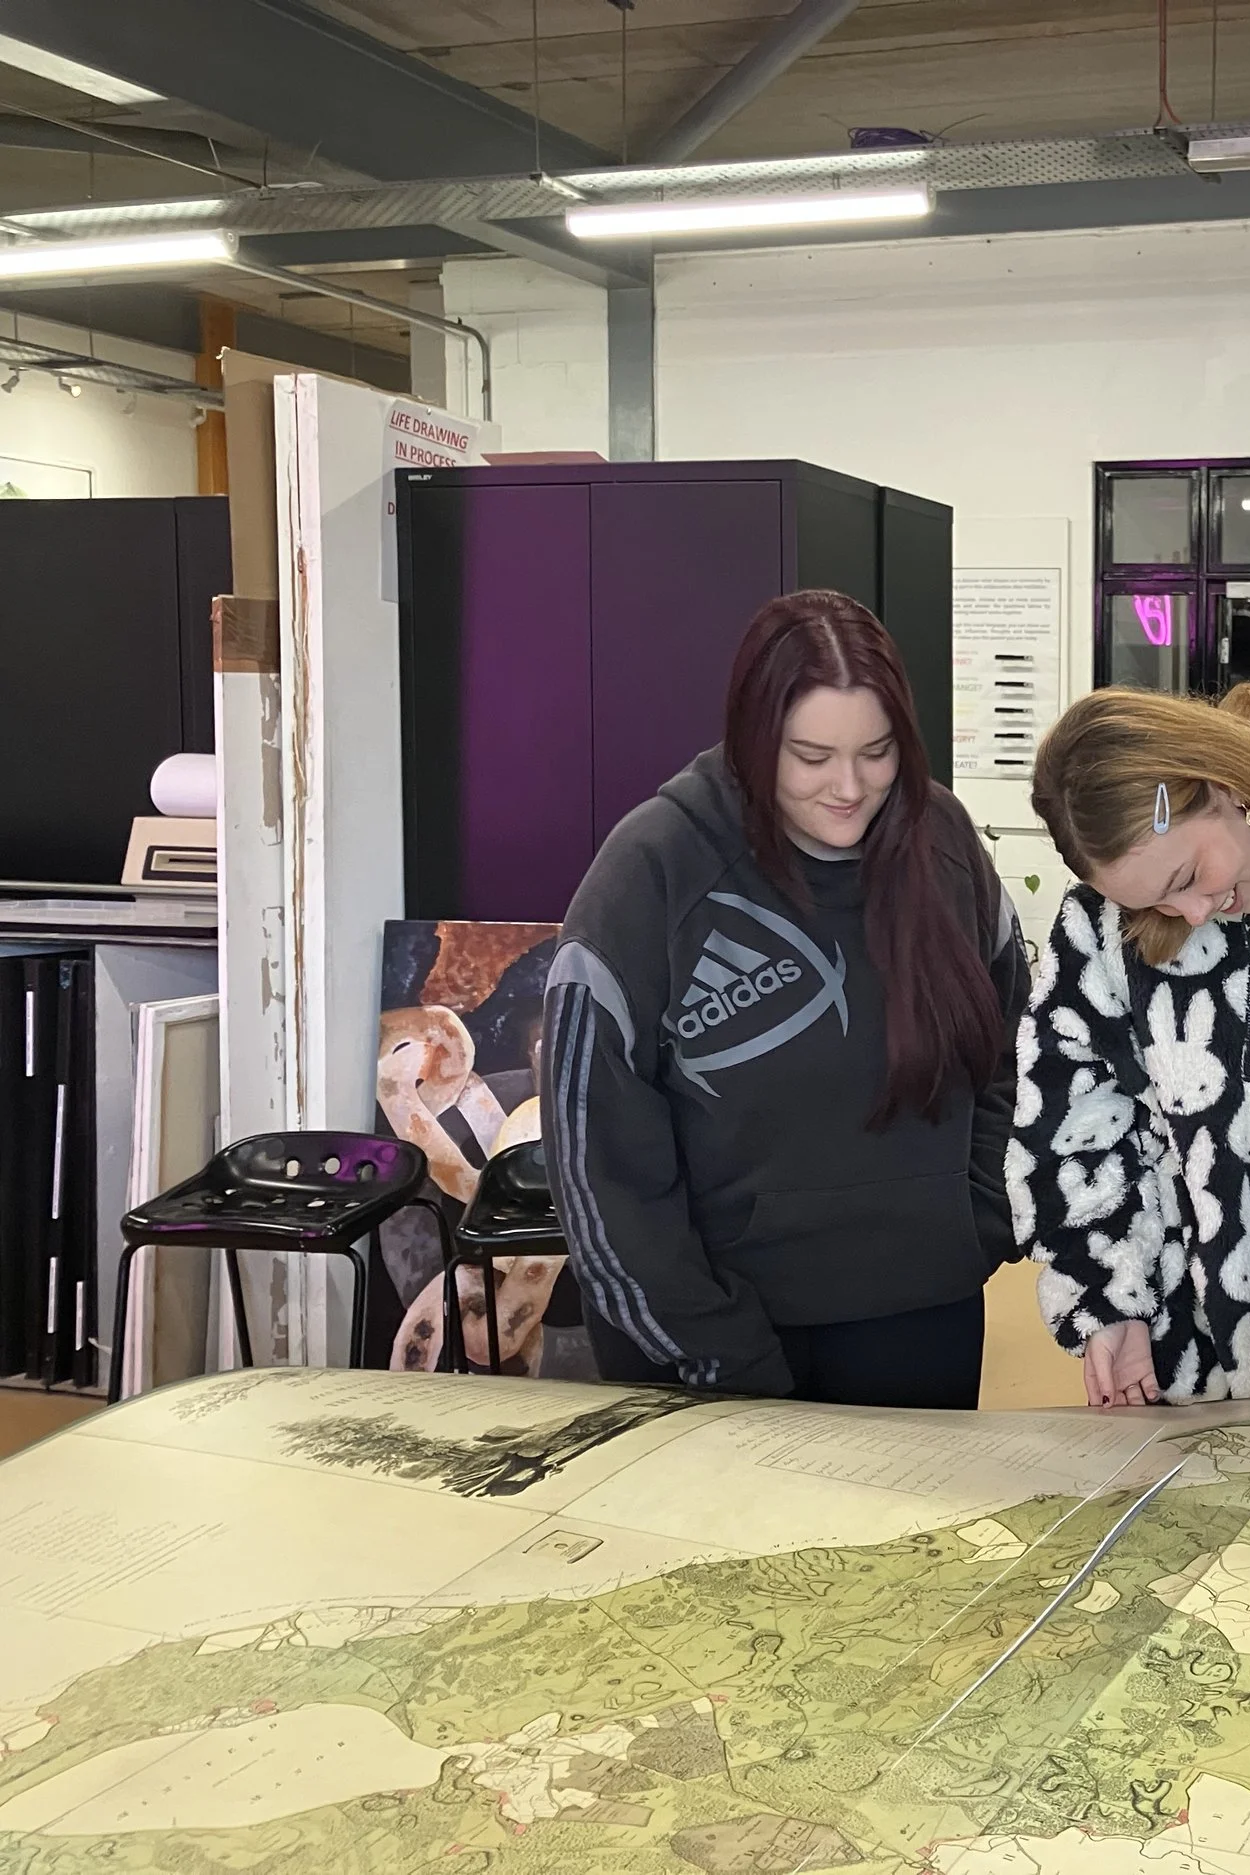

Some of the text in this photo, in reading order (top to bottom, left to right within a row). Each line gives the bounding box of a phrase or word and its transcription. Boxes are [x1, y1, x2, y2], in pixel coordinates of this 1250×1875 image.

[391, 409, 469, 450] LIFE DRAWING
[395, 440, 408, 458] IN
[678, 959, 802, 1039] adidas
